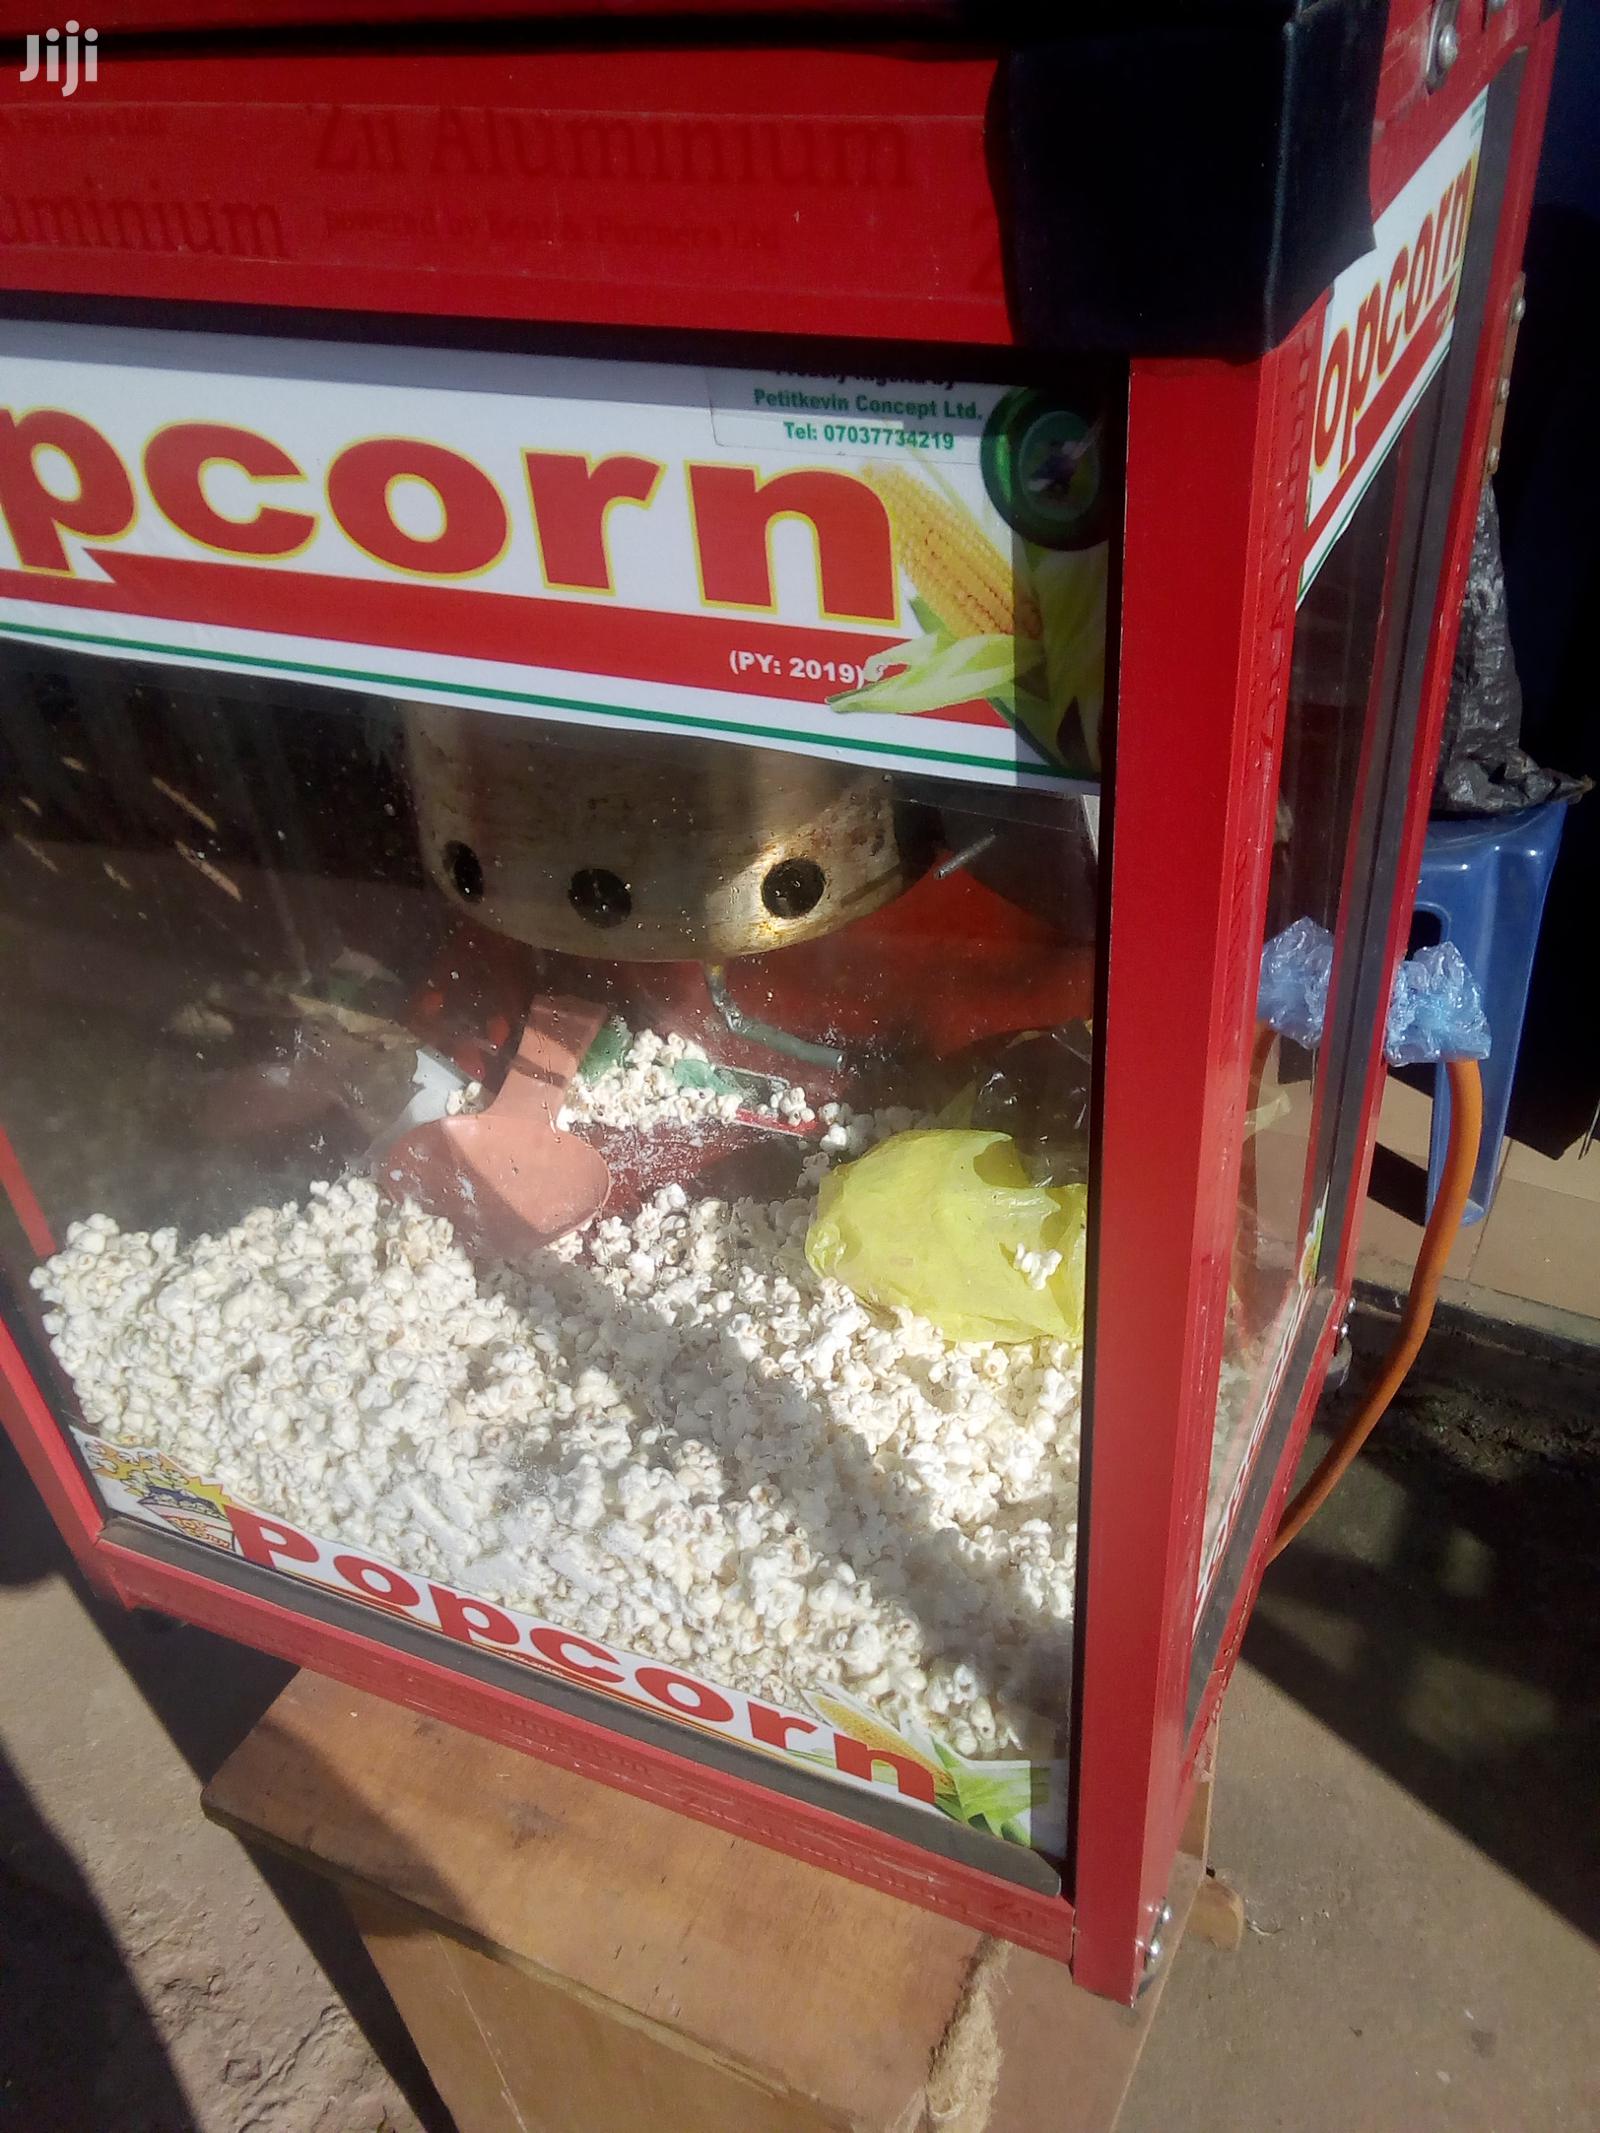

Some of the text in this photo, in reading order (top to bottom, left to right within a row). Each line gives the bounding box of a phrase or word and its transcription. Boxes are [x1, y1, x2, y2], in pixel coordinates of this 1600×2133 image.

[754, 389, 982, 420] Petitkevin Concept Ltd.
[784, 422, 955, 449] Tel: 07037734219
[0, 406, 900, 628] pcorn
[729, 650, 865, 690] (PY: 2019)
[223, 1503, 936, 1803] Popcorn
